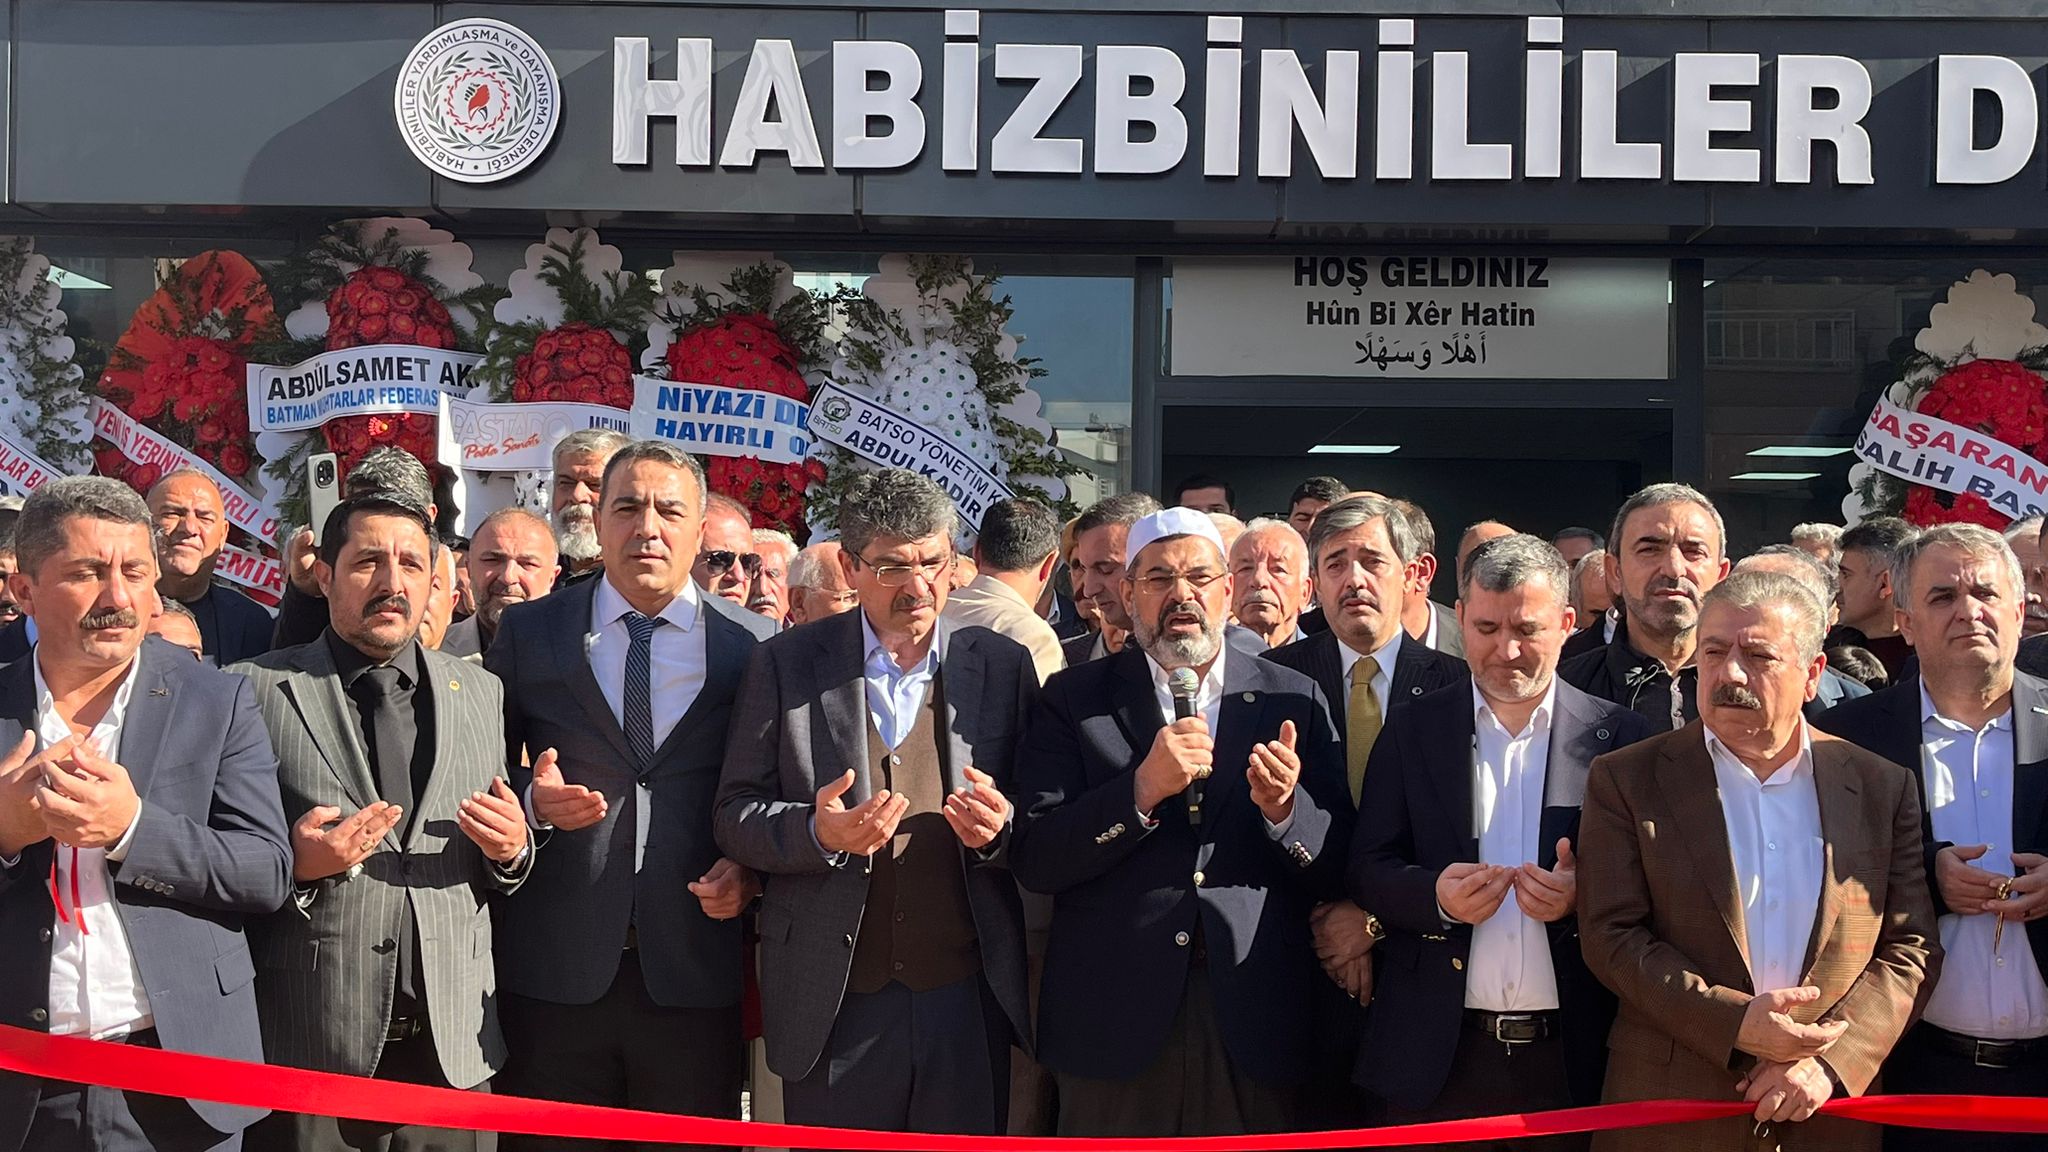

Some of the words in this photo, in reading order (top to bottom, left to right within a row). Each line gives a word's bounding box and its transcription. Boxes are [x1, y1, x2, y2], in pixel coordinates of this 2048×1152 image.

[411, 29, 500, 76] YARDIMLAŞMA
[505, 38, 518, 51] ve
[519, 49, 549, 126] DAYANIŞMA
[613, 9, 1875, 184] HABİZBİNİLİLER
[487, 131, 540, 173] DERNEĞİ
[1294, 257, 1368, 296] HOŞ
[1307, 300, 1360, 325] Hûn
[1370, 301, 1396, 326] Bi
[1405, 300, 1452, 326] Xêr
[1461, 302, 1535, 327] Hatin
[267, 356, 431, 401] ABDÜLSAMET
[439, 361, 480, 389] AK
[267, 403, 317, 424] BATMAN
[379, 387, 466, 408] FEDERAS
[812, 414, 843, 435] BATSO
[463, 443, 499, 460] Pasta
[655, 418, 774, 450] HAYIRLI
[858, 409, 916, 445] BATSO
[919, 437, 989, 496] YÖNETİM
[1870, 402, 2048, 496] BAŞARAN
[215, 550, 284, 592] EMİR
